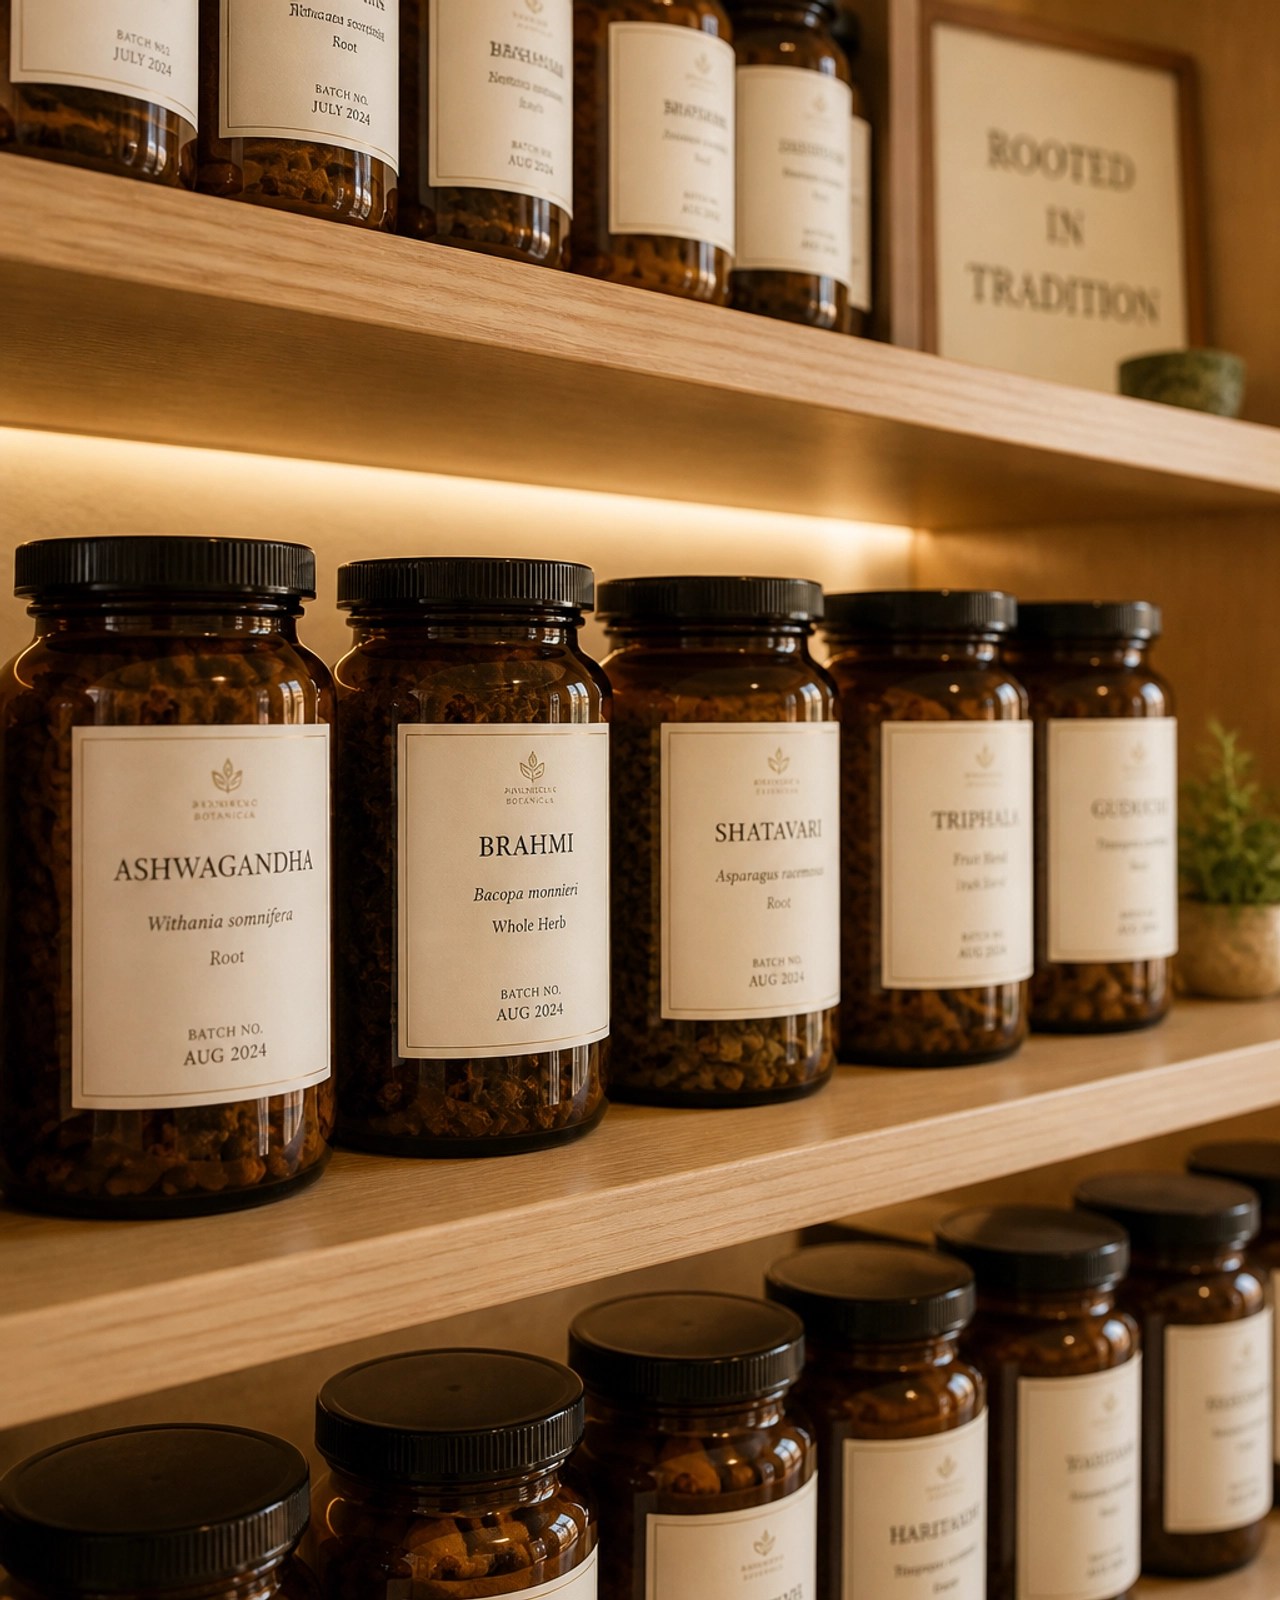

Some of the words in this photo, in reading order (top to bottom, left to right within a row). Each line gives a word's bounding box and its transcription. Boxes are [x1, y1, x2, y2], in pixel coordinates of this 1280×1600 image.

[116, 29, 152, 50] BATCH
[332, 35, 358, 54] Root
[113, 46, 145, 67] JULY
[148, 57, 173, 77] 2024
[315, 83, 351, 101] BATCH
[311, 100, 344, 117] JULY
[346, 107, 371, 126] 2024
[508, 154, 533, 170] AUG
[988, 127, 1136, 193] ROOTED
[1045, 204, 1085, 247] IN
[967, 262, 1162, 326] TRADITION
[715, 819, 822, 843] SHATAVARI
[479, 832, 574, 858] BRAHMI
[113, 849, 314, 882] ASHWAGANDHA
[715, 869, 779, 886] Asparagus
[473, 886, 524, 905] Bacopa
[528, 881, 578, 899] monnieri
[767, 897, 792, 910] Root
[148, 913, 224, 933] Withania
[227, 908, 294, 929] somnifera
[492, 918, 534, 934] Whole
[538, 915, 566, 931] Herb
[209, 950, 245, 967] Root
[752, 957, 786, 968] BATCH
[749, 974, 778, 988] AUG
[782, 971, 805, 985] 2024
[500, 988, 539, 1000] BATCH
[543, 985, 562, 997] NO.
[496, 1006, 530, 1022] AUG
[534, 1001, 564, 1018] 2024
[188, 1026, 236, 1041] BATCH
[240, 1023, 264, 1036] NO.
[183, 1050, 224, 1066] AUG
[230, 1042, 267, 1062] 2024
